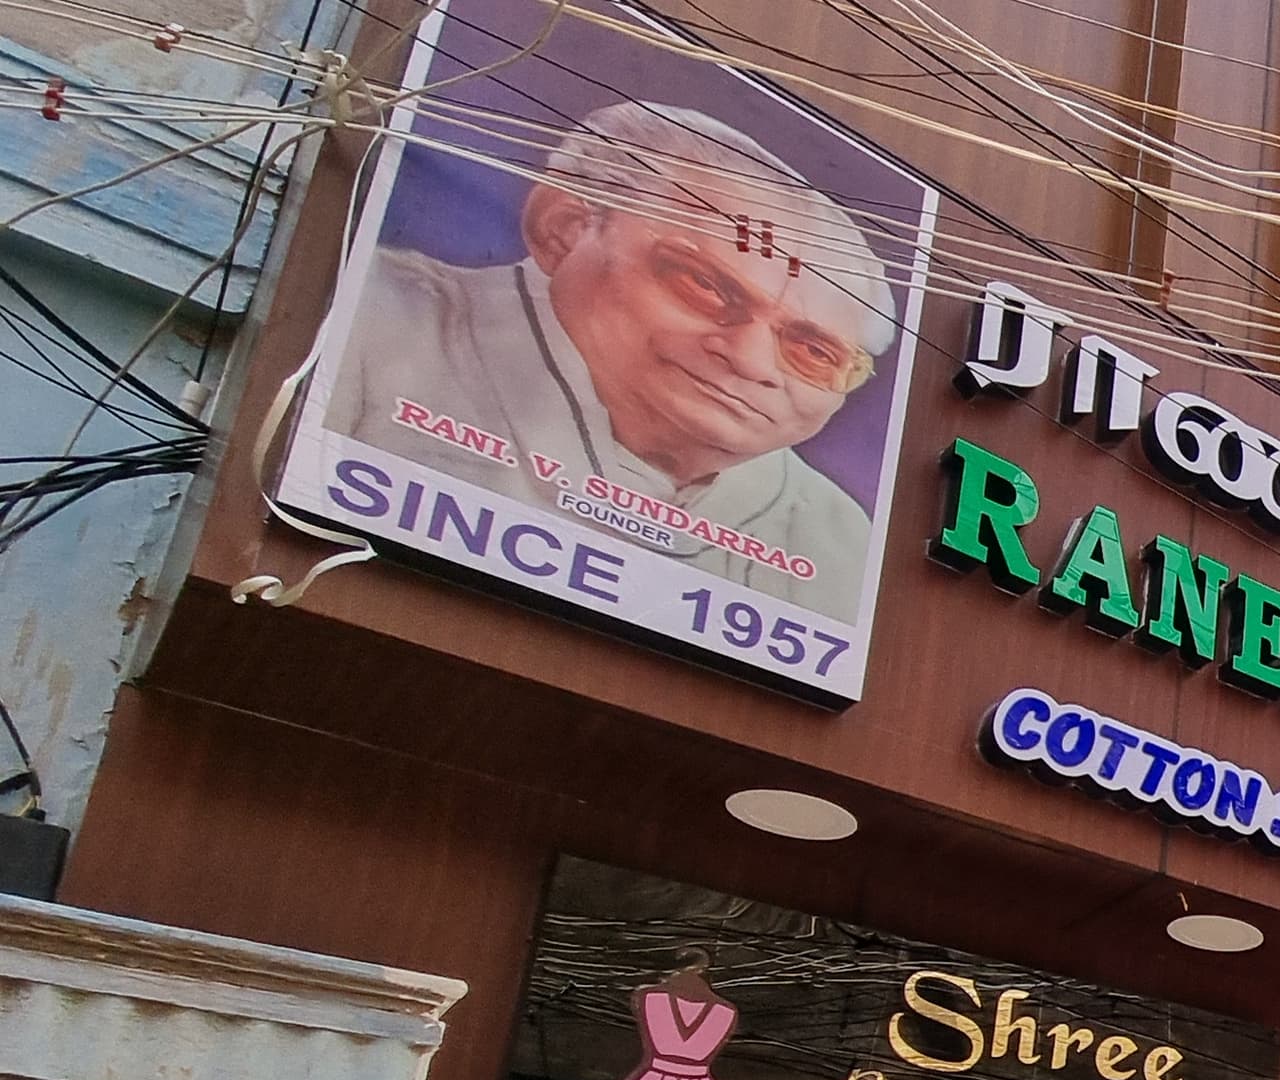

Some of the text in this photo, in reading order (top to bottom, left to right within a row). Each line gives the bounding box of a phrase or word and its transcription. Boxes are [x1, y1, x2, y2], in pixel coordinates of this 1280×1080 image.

[393, 398, 818, 581] RANI. V. SUNDARRAO
[560, 494, 672, 546] FOUNDER
[327, 458, 851, 678] SINCE 1957
[1002, 696, 1263, 825] COTTON
